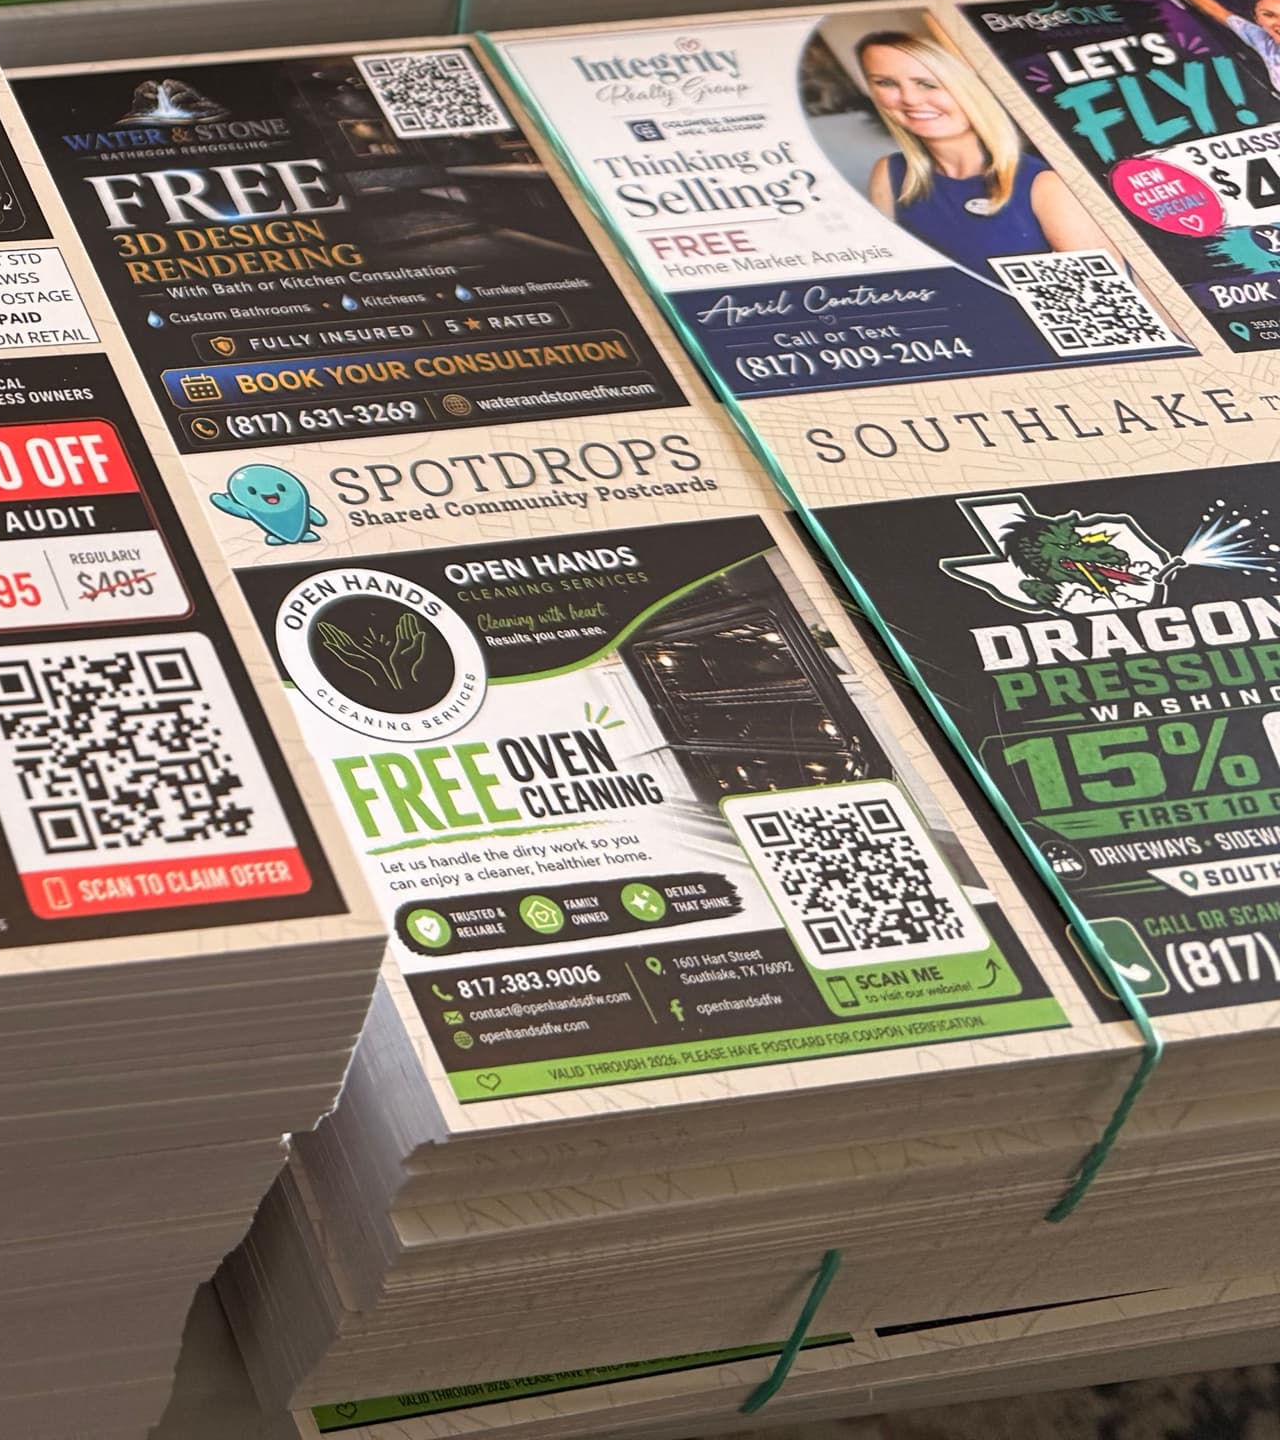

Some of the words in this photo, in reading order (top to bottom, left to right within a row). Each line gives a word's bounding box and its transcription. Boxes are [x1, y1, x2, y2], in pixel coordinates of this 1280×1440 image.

[1047, 36, 1179, 85] LET'S
[1051, 55, 1248, 164] FLY!
[82, 160, 348, 230] FREE
[1128, 167, 1165, 190] NEW
[1133, 179, 1186, 208] CLIENT
[113, 231, 172, 258] 3D
[181, 218, 329, 252] DESIGN
[646, 230, 756, 260] FREE
[124, 244, 365, 285] RENDERING
[734, 350, 818, 381] (817)
[824, 336, 974, 371] 909-2044
[475, 380, 655, 413] waterandstonedfw.com
[225, 410, 292, 439] (817)
[299, 400, 419, 431] 631-3269
[38, 433, 112, 489] OFF
[444, 558, 522, 586] OPEN
[528, 546, 638, 579] HANDS
[494, 727, 619, 783] OVEN
[1003, 717, 1261, 810] 15%
[332, 742, 521, 840] FREE
[518, 773, 664, 821] CLEANING
[672, 956, 701, 969] 1601
[701, 953, 727, 966] Hart
[727, 949, 763, 962] Street
[680, 967, 740, 985] Southlake,
[739, 963, 758, 978] TX
[760, 960, 796, 976] 76092
[1165, 932, 1280, 998] (817)
[456, 965, 602, 1001] 817.383.9006
[398, 1393, 430, 1408] VALID
[431, 1383, 484, 1403] THROUGH
